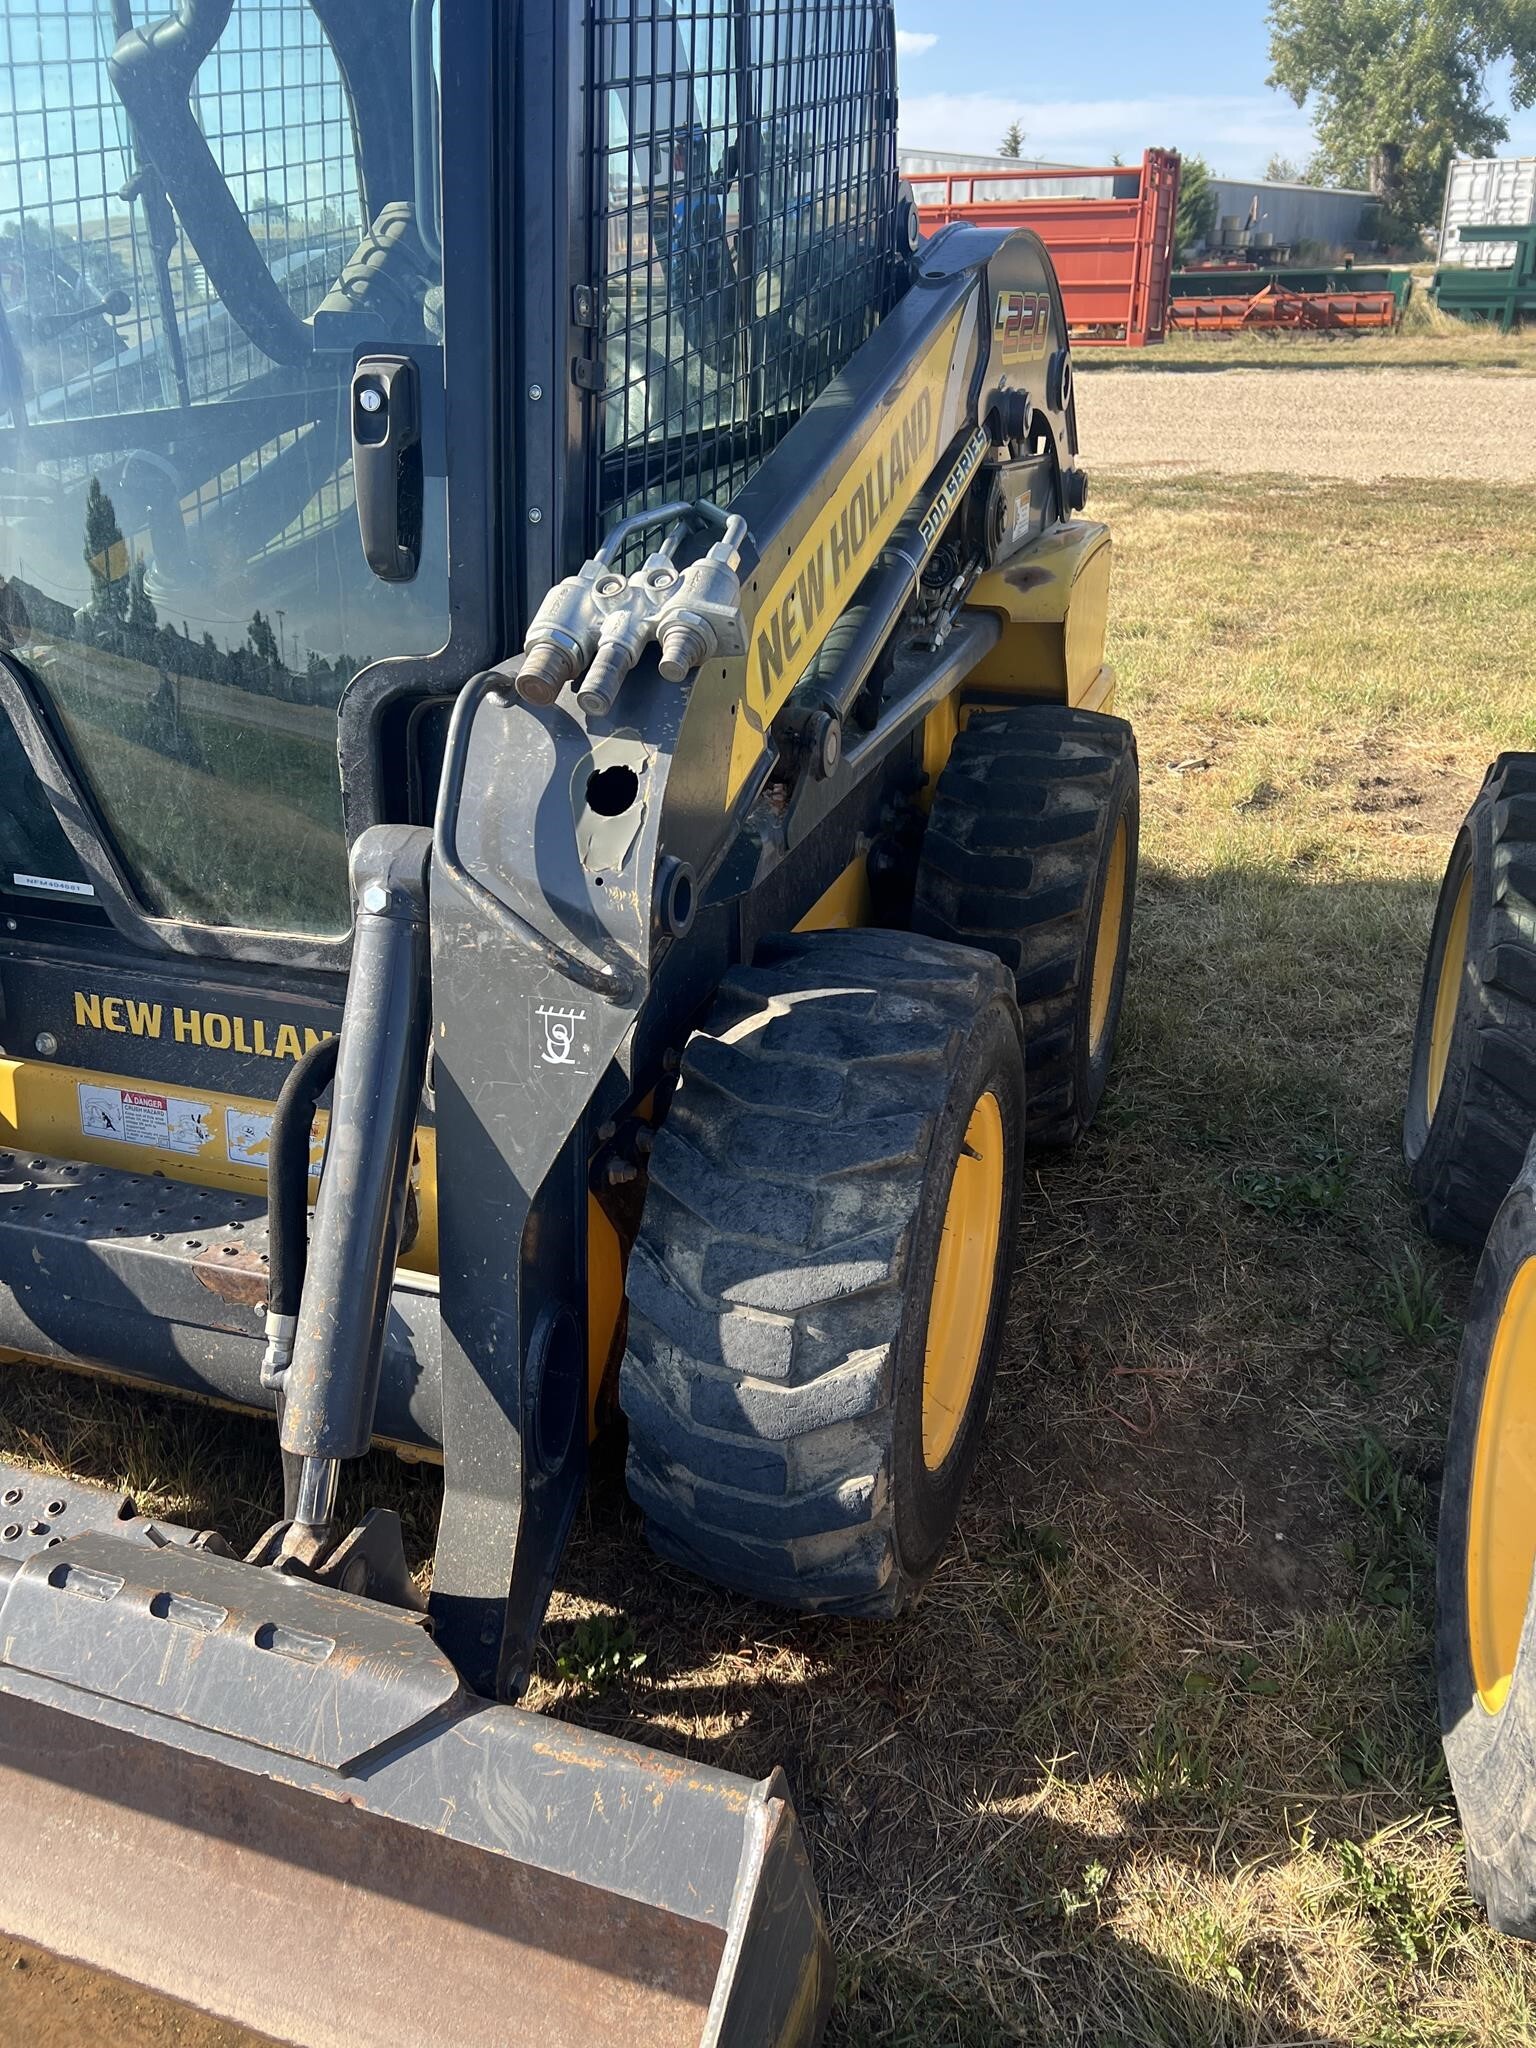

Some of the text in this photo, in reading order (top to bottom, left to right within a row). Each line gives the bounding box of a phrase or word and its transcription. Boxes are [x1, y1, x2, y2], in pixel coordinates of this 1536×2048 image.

[921, 427, 986, 544] 200 SERIES
[757, 386, 931, 700] NEW HOLLAND
[74, 991, 341, 1062] NEW HOLLAN
[134, 1097, 162, 1107] DANGER
